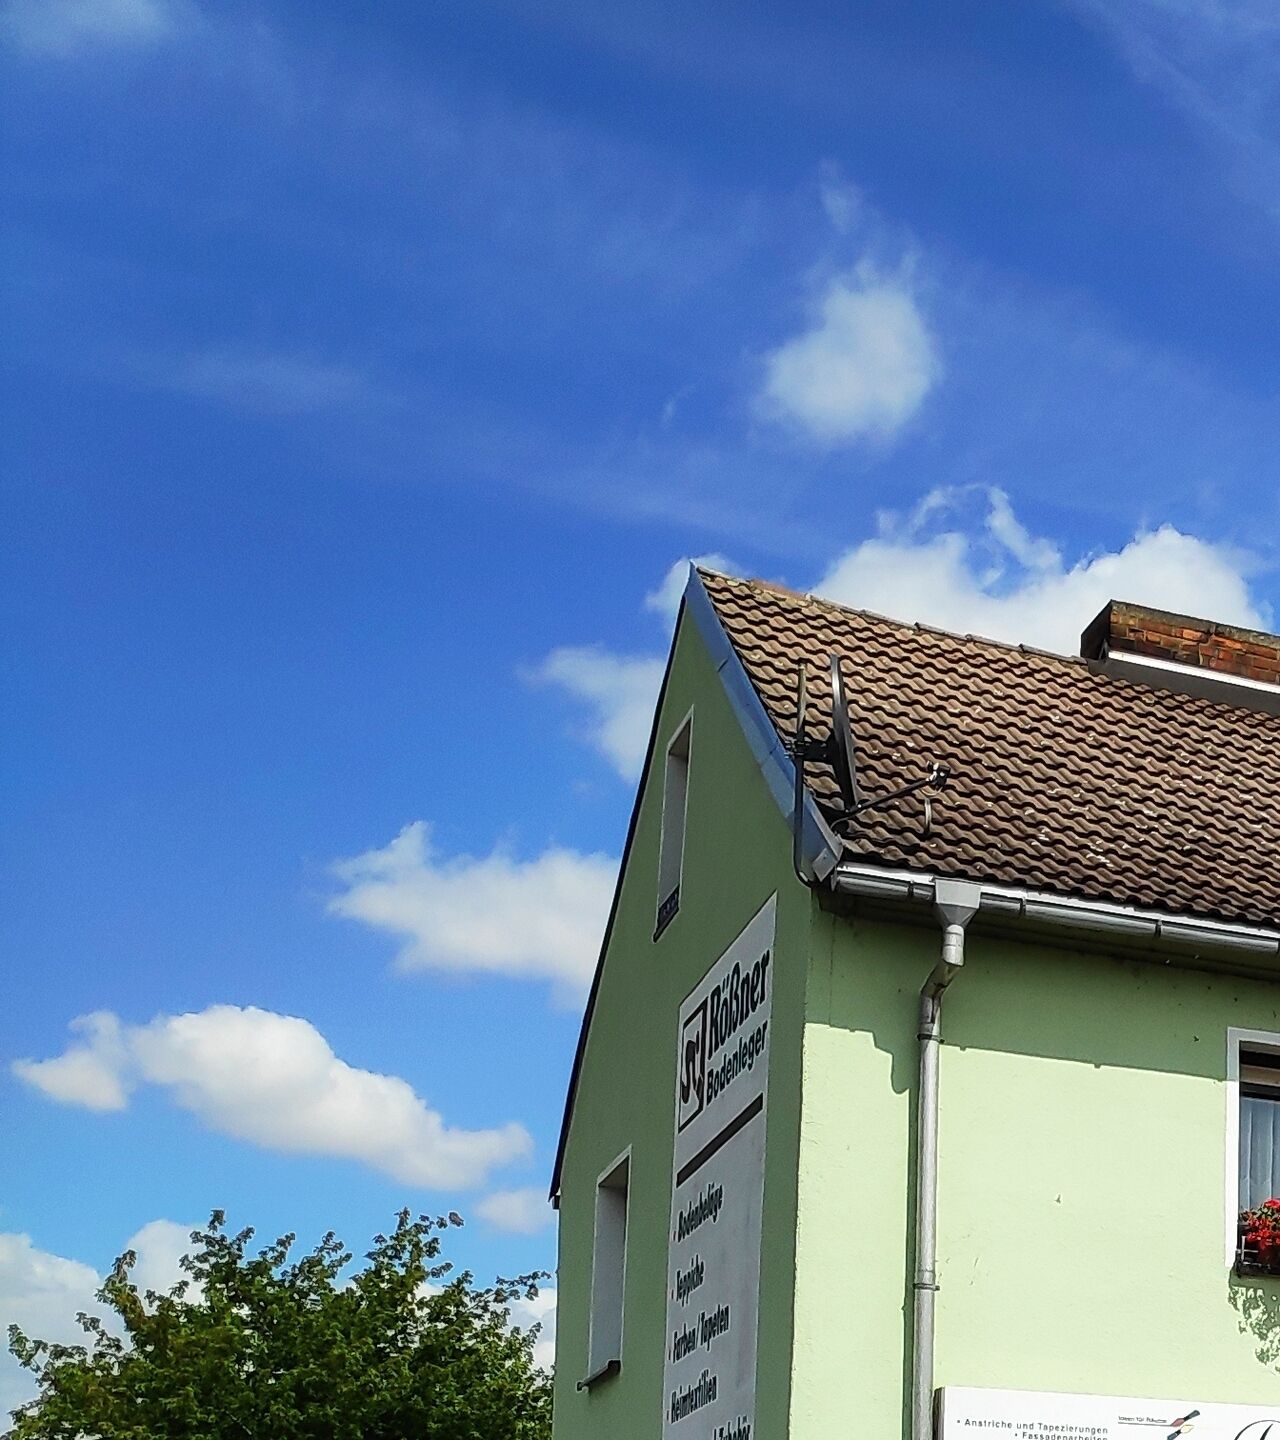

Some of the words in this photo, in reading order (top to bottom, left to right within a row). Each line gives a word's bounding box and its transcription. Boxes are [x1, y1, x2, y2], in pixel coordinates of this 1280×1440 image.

[707, 949, 770, 1060] Rößner
[707, 1020, 768, 1106] Bodenleger
[964, 1418, 1012, 1429] Anstriche
[1016, 1422, 1034, 1430] und
[1038, 1423, 1108, 1435] Tapezierungen
